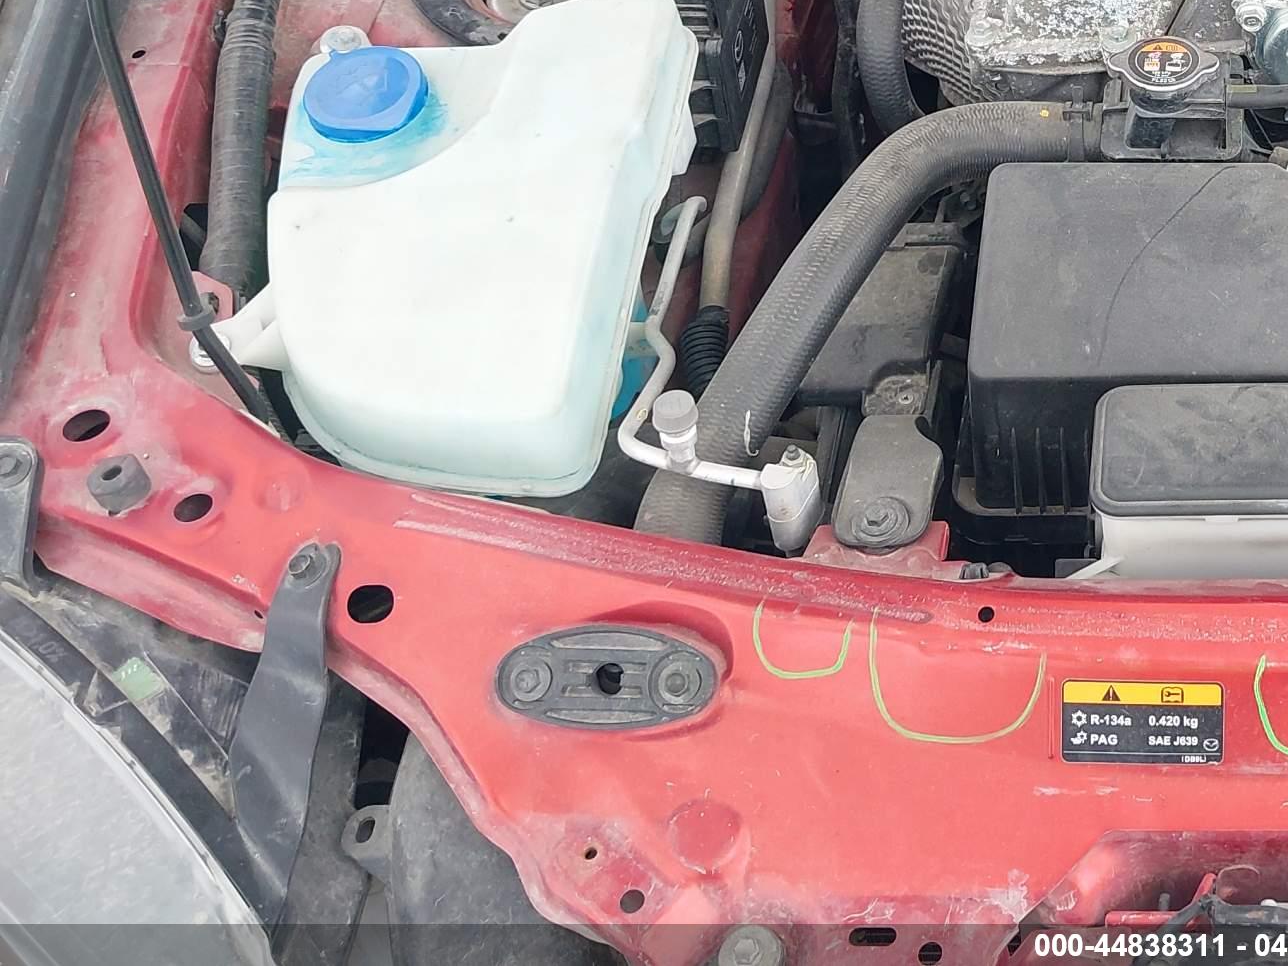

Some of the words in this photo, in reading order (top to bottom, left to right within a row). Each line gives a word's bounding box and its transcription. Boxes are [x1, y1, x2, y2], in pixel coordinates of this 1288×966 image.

[1090, 714, 1132, 726] R-134a
[1148, 716, 1180, 727] 0.420
[1183, 715, 1199, 729] kg
[1090, 734, 1118, 745] PAG
[1148, 736, 1171, 746] SAE
[1173, 736, 1198, 746] J639
